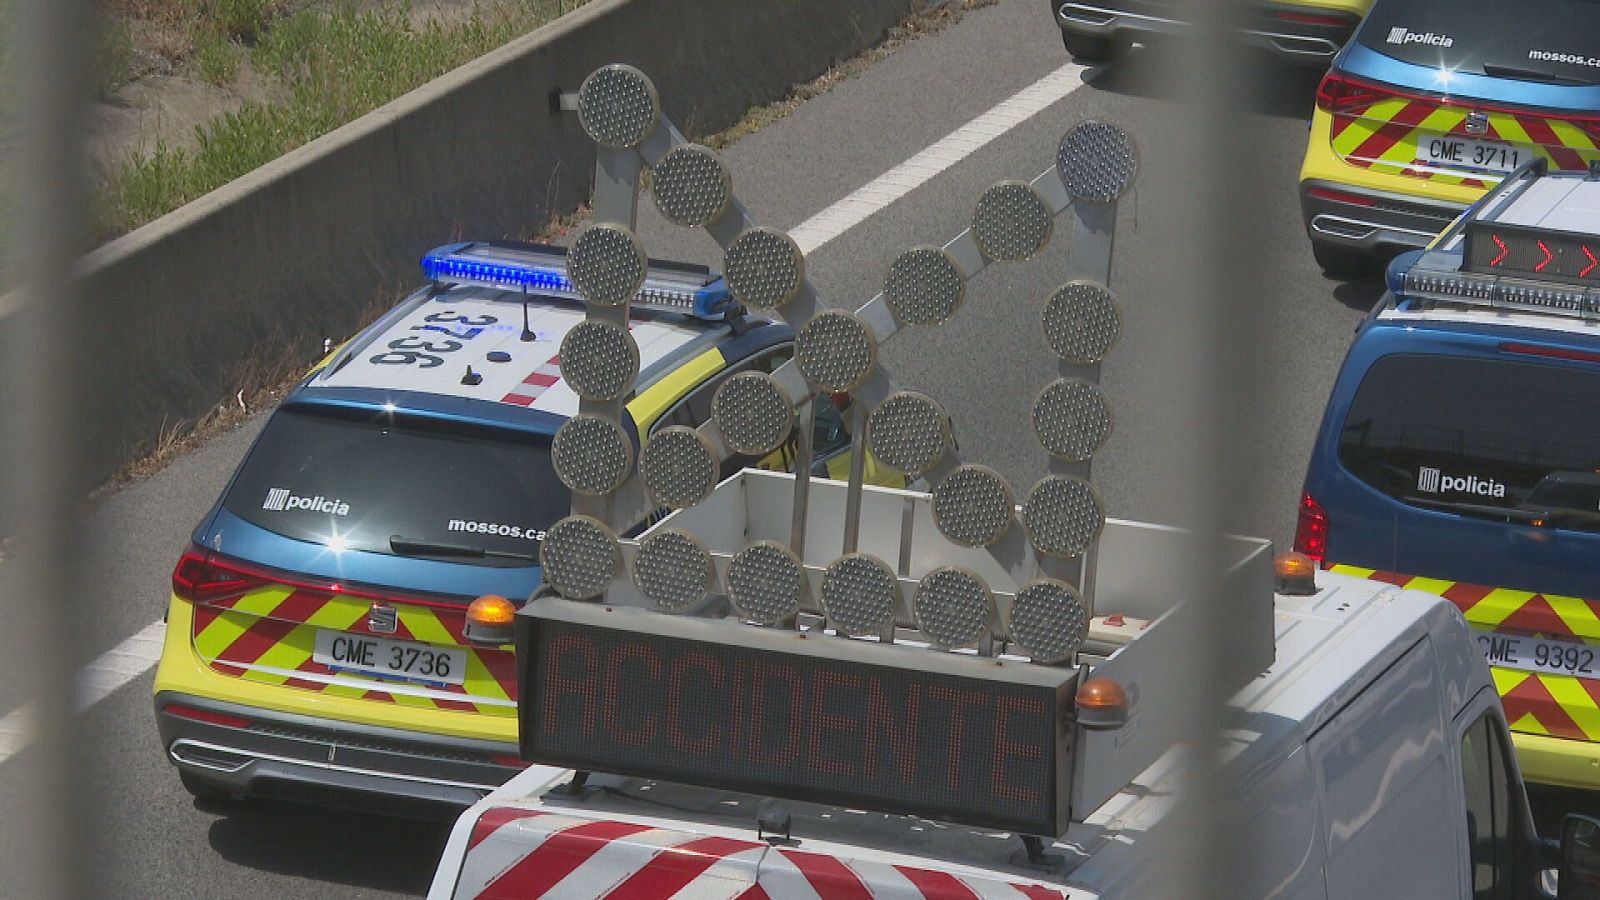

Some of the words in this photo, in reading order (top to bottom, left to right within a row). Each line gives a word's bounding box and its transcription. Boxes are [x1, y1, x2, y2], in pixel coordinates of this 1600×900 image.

[1403, 31, 1453, 48] policia
[1429, 139, 1466, 162] CME
[1473, 147, 1519, 169] 3711
[369, 311, 498, 368] 3736
[1440, 475, 1505, 498] policia
[285, 495, 350, 516] policia
[331, 638, 377, 667] CME
[388, 646, 451, 677] 3736
[1534, 643, 1593, 673] 9392
[542, 632, 1046, 801] ACCIDENTE
